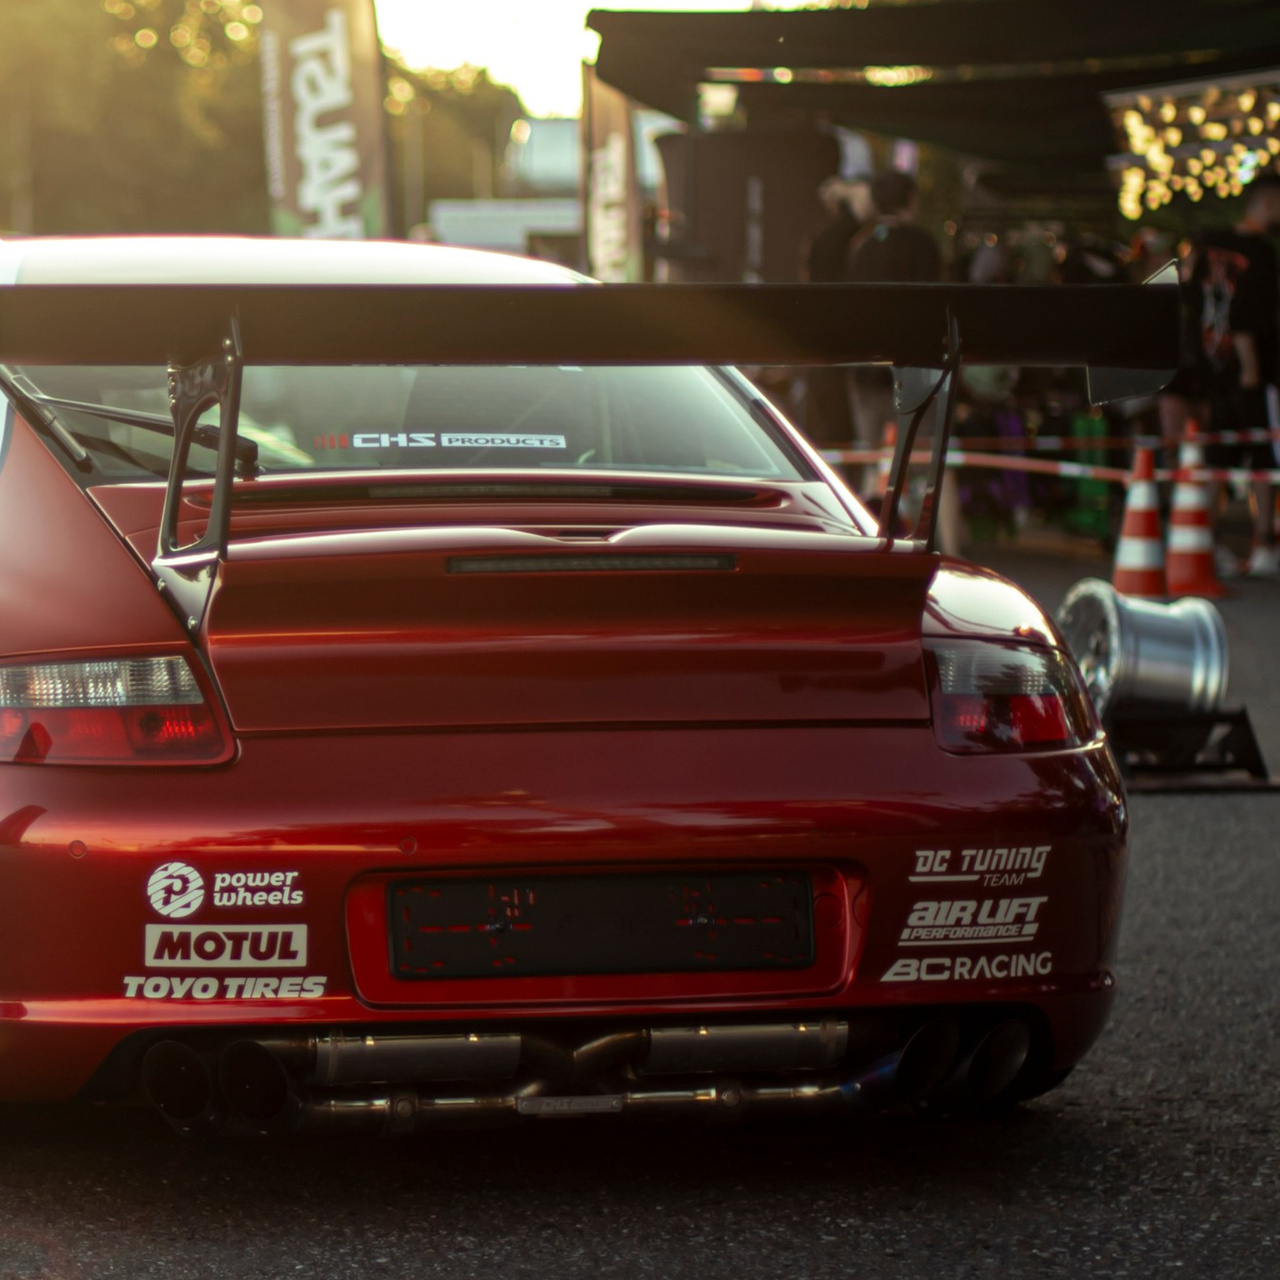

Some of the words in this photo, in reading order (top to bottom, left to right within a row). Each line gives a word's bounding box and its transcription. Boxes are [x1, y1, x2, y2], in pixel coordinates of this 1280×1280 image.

[353, 432, 437, 448] CHS
[447, 436, 561, 447] PRODUCTS
[914, 849, 952, 873] DC
[214, 871, 299, 891] power
[982, 872, 1026, 888] TEAM
[213, 886, 304, 907] wheels
[152, 930, 300, 962] MOTUL
[953, 951, 1053, 981] RACING
[123, 975, 220, 999] TOYO
[223, 975, 328, 999] TIRES
